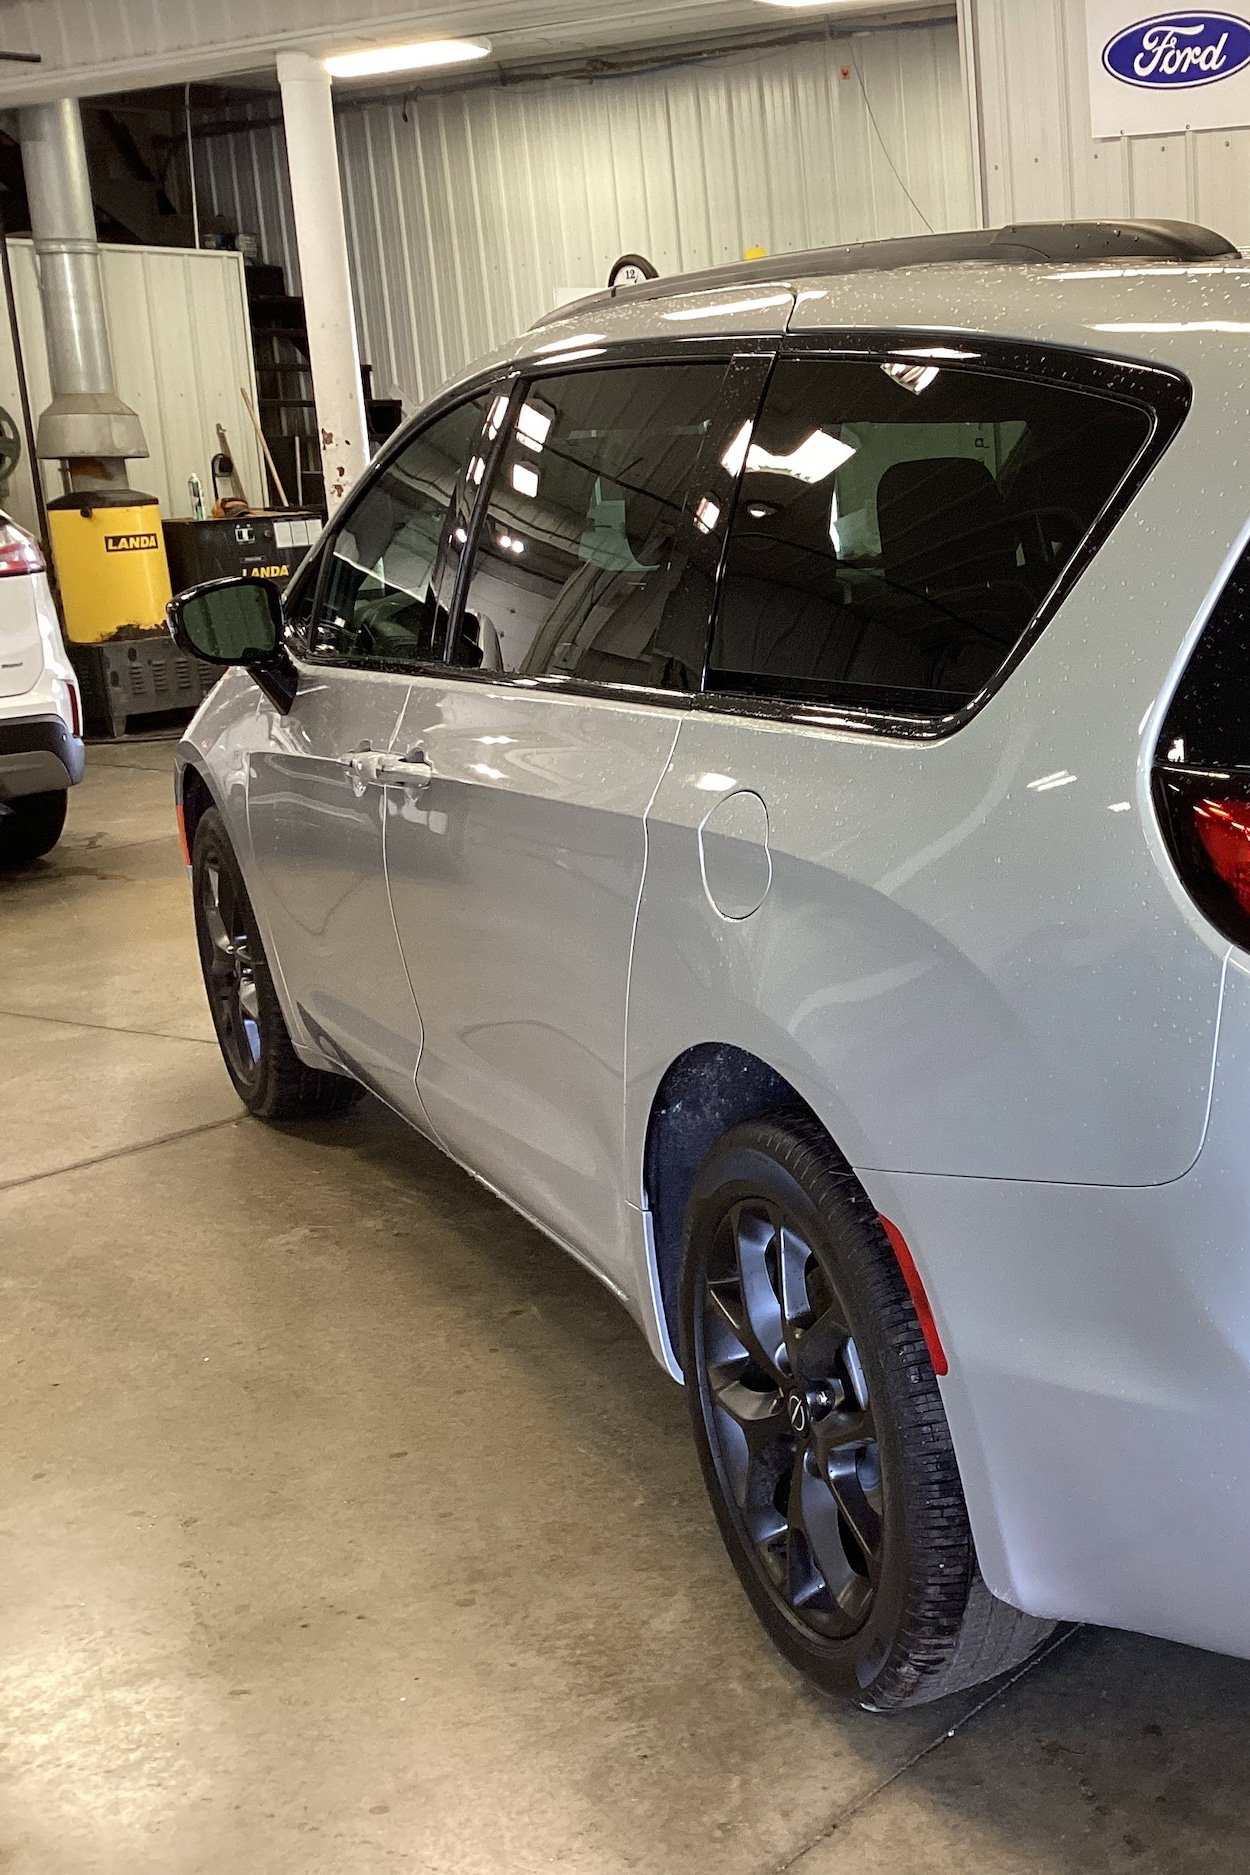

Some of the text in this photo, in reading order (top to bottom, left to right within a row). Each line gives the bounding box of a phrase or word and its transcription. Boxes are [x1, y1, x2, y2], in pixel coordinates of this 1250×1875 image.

[1133, 23, 1229, 77] Ford
[625, 269, 636, 279] 12
[107, 534, 157, 551] LANDA
